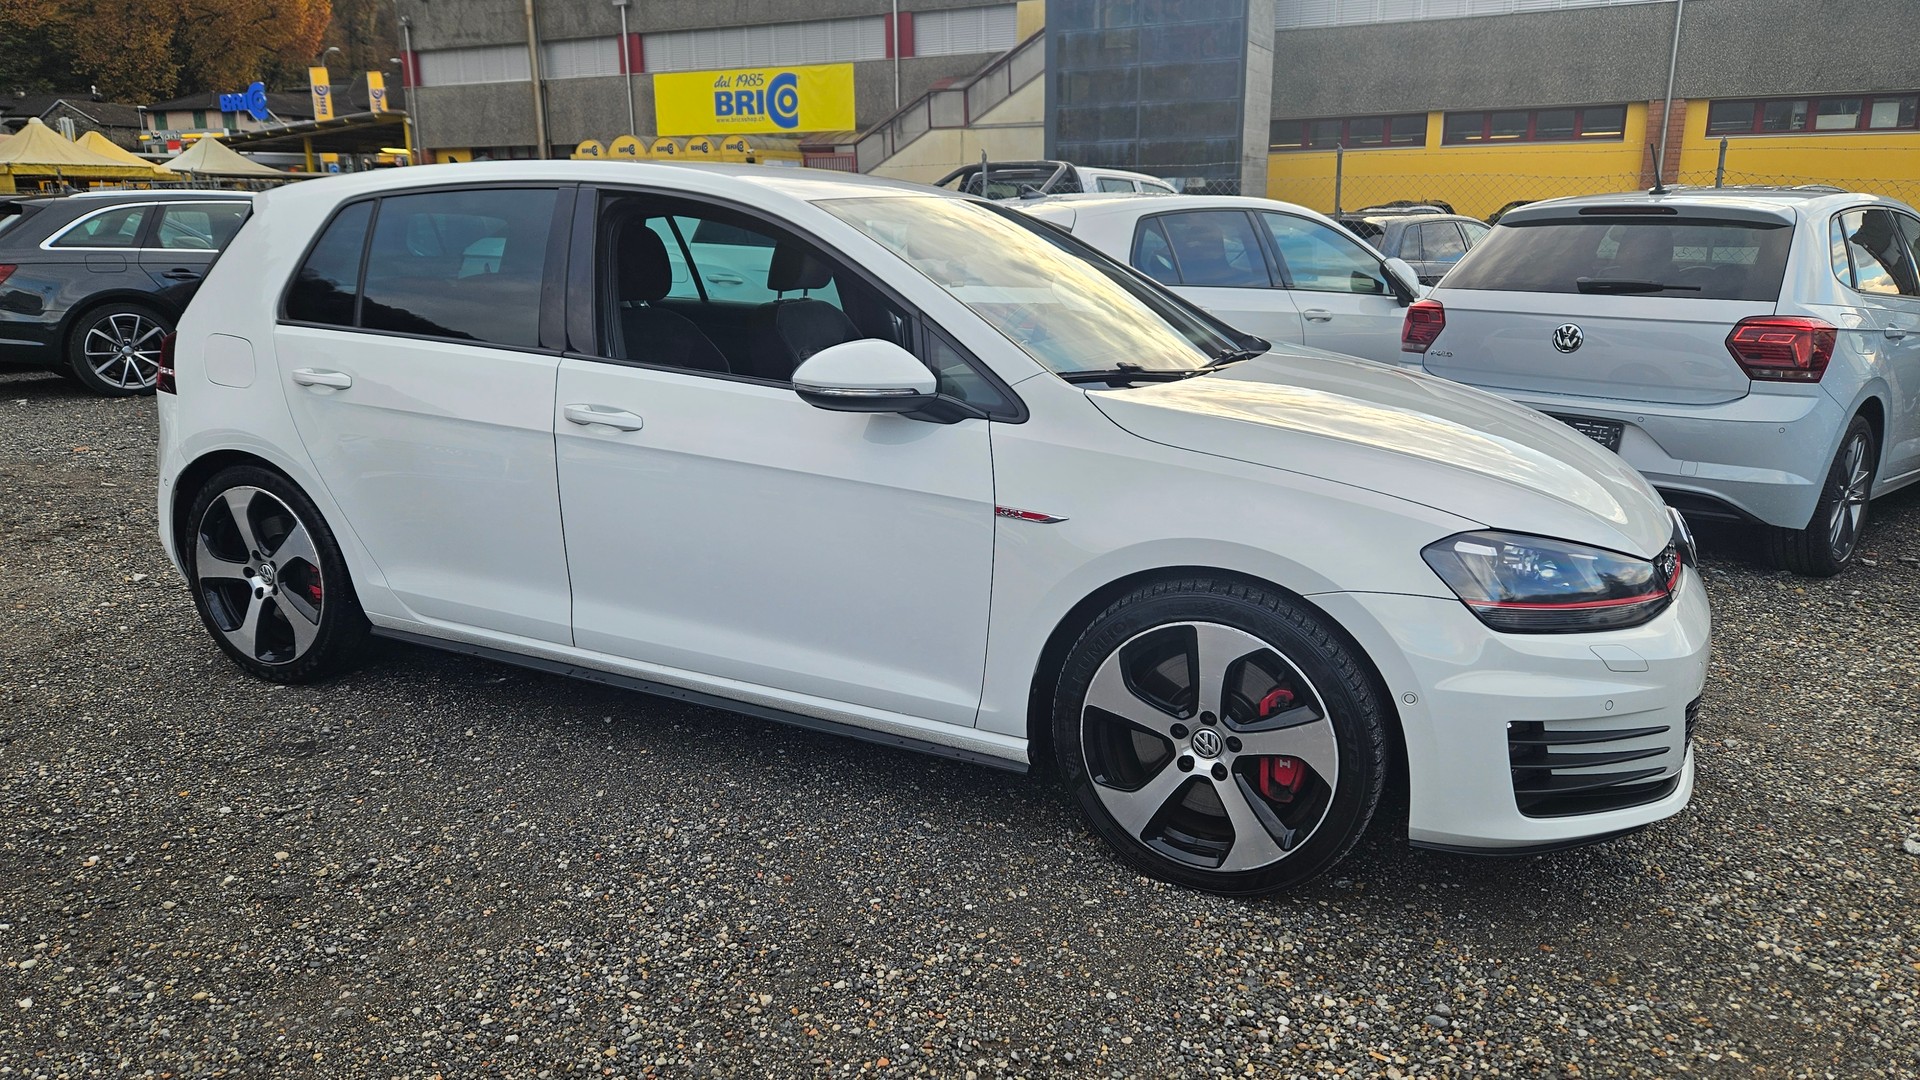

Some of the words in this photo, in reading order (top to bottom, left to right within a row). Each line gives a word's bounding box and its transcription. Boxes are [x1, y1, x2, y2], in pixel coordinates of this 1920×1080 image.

[714, 75, 731, 88] dal
[736, 73, 764, 87] 1985
[219, 81, 269, 120] BRICO
[714, 72, 799, 129] BRICO
